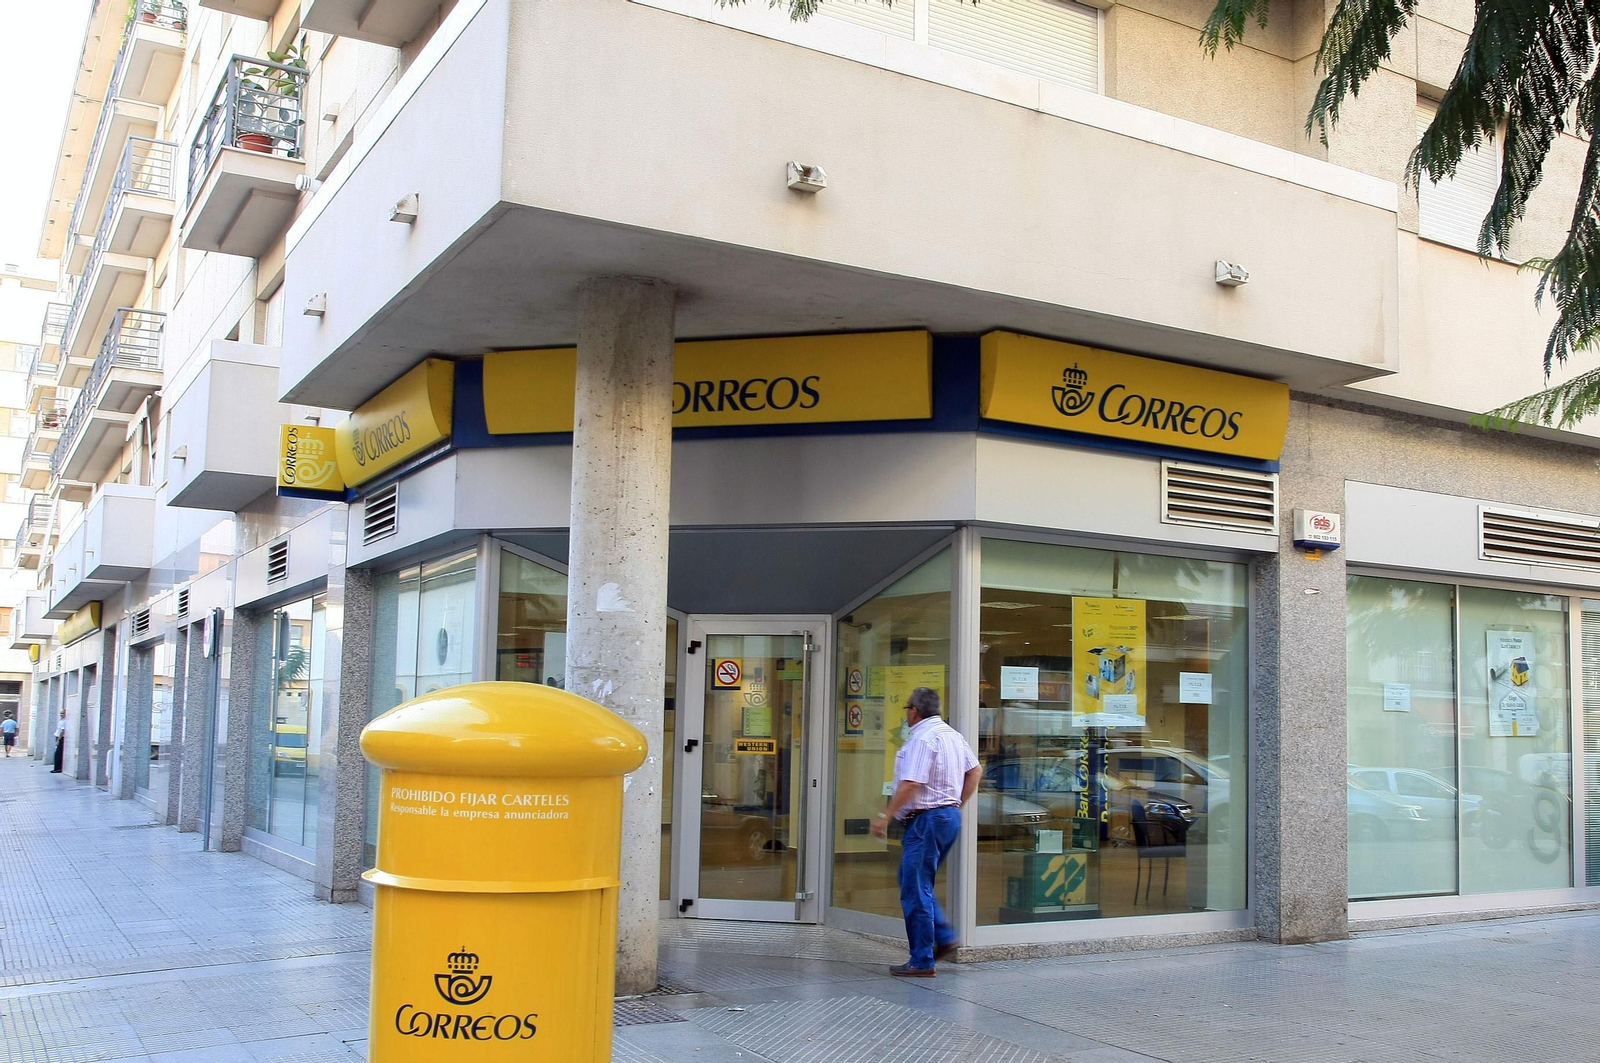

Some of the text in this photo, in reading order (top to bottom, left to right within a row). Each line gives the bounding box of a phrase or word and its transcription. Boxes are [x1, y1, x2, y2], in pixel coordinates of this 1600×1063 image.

[672, 375, 821, 414] ORREOS
[1098, 384, 1243, 441] CORREOS
[364, 411, 411, 460] CORREOS
[283, 427, 298, 484] CORREOS
[390, 802, 570, 821] Responsable la empresa anunciadora
[391, 787, 570, 807] PROHIBIDO FIJAR CARTELES
[395, 1004, 538, 1041] CORREOS
